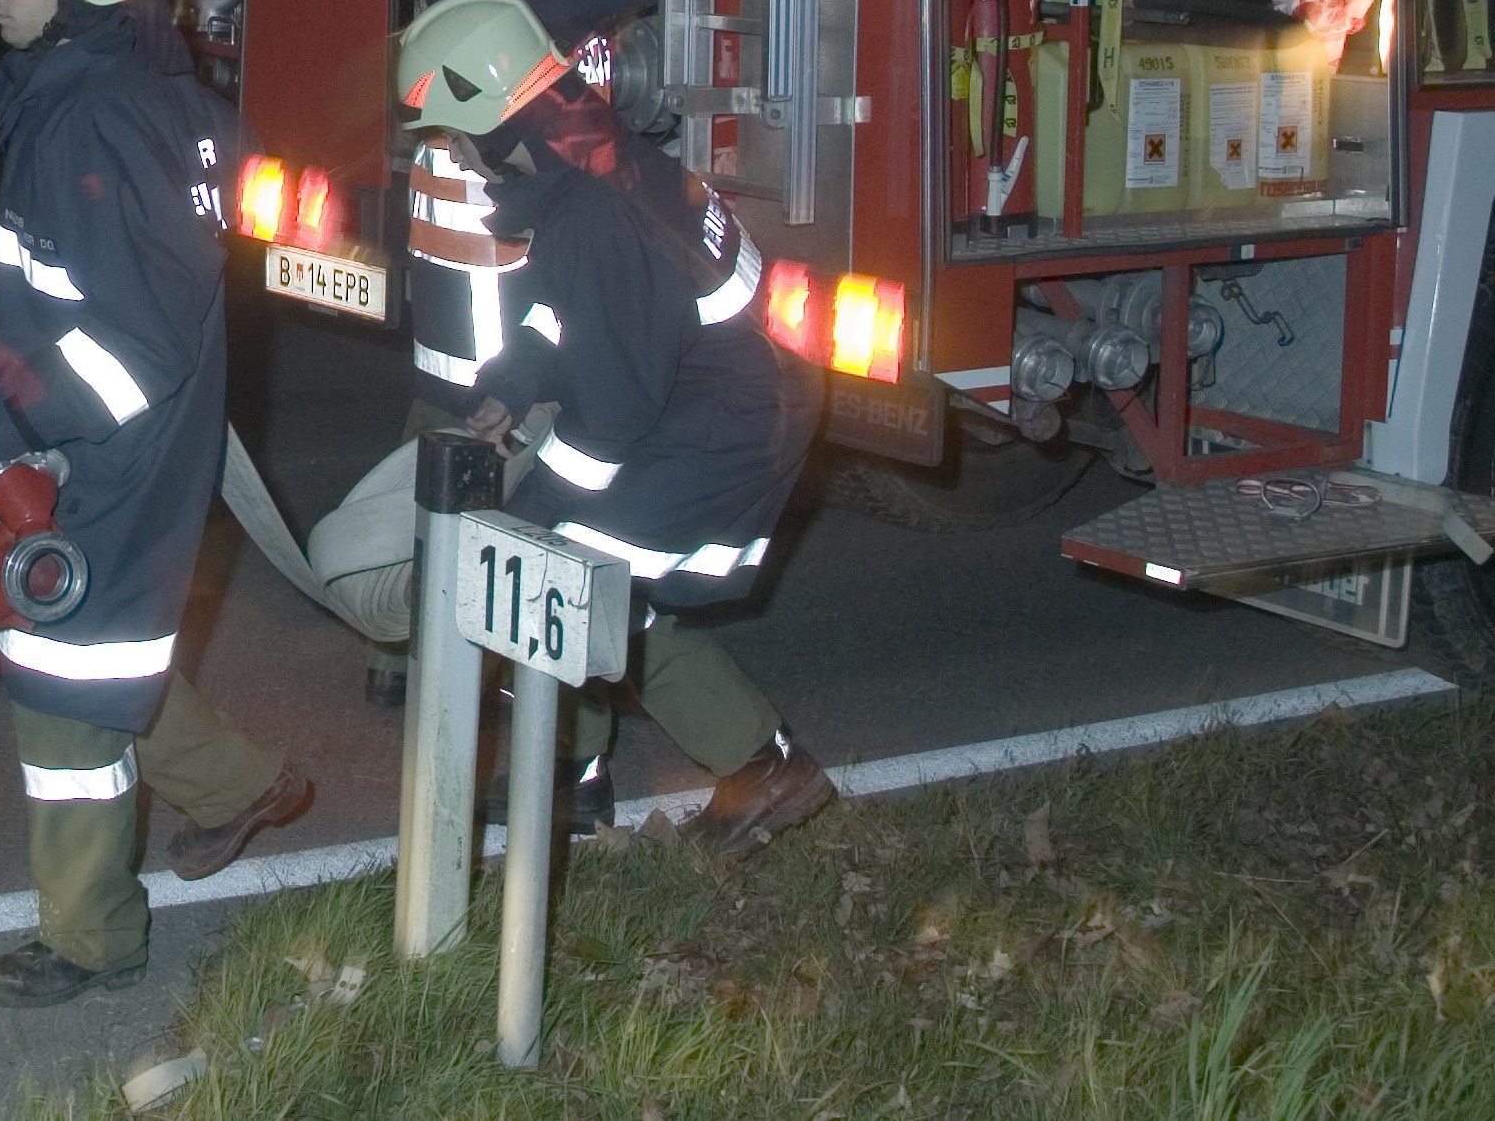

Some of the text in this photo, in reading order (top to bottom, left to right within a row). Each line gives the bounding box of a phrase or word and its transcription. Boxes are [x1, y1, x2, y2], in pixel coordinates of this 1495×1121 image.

[280, 255, 369, 306] B 14 EPB
[480, 544, 564, 661] 11,6
